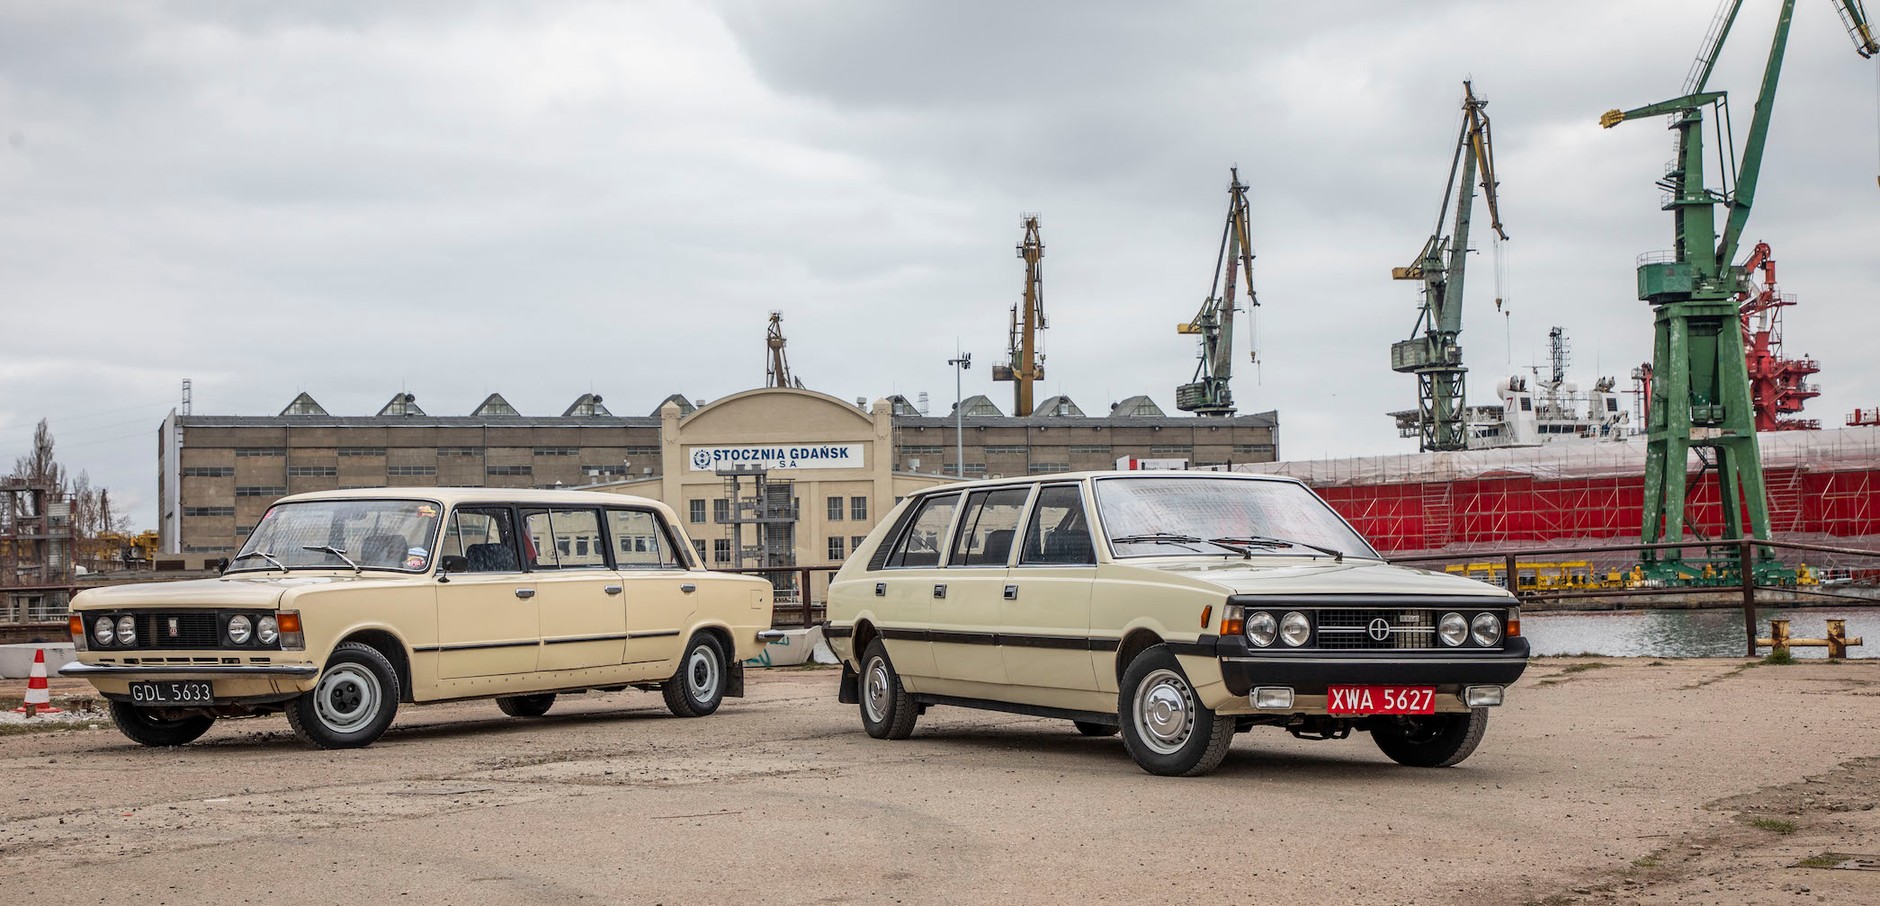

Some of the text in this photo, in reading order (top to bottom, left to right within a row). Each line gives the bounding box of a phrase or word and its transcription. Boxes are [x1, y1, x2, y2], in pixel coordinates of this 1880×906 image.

[1506, 396, 1514, 411] 7
[713, 445, 849, 461] STOCZNIA GDAŃSK
[132, 684, 210, 701] GDL 5633
[1331, 688, 1433, 711] XWA 5627
